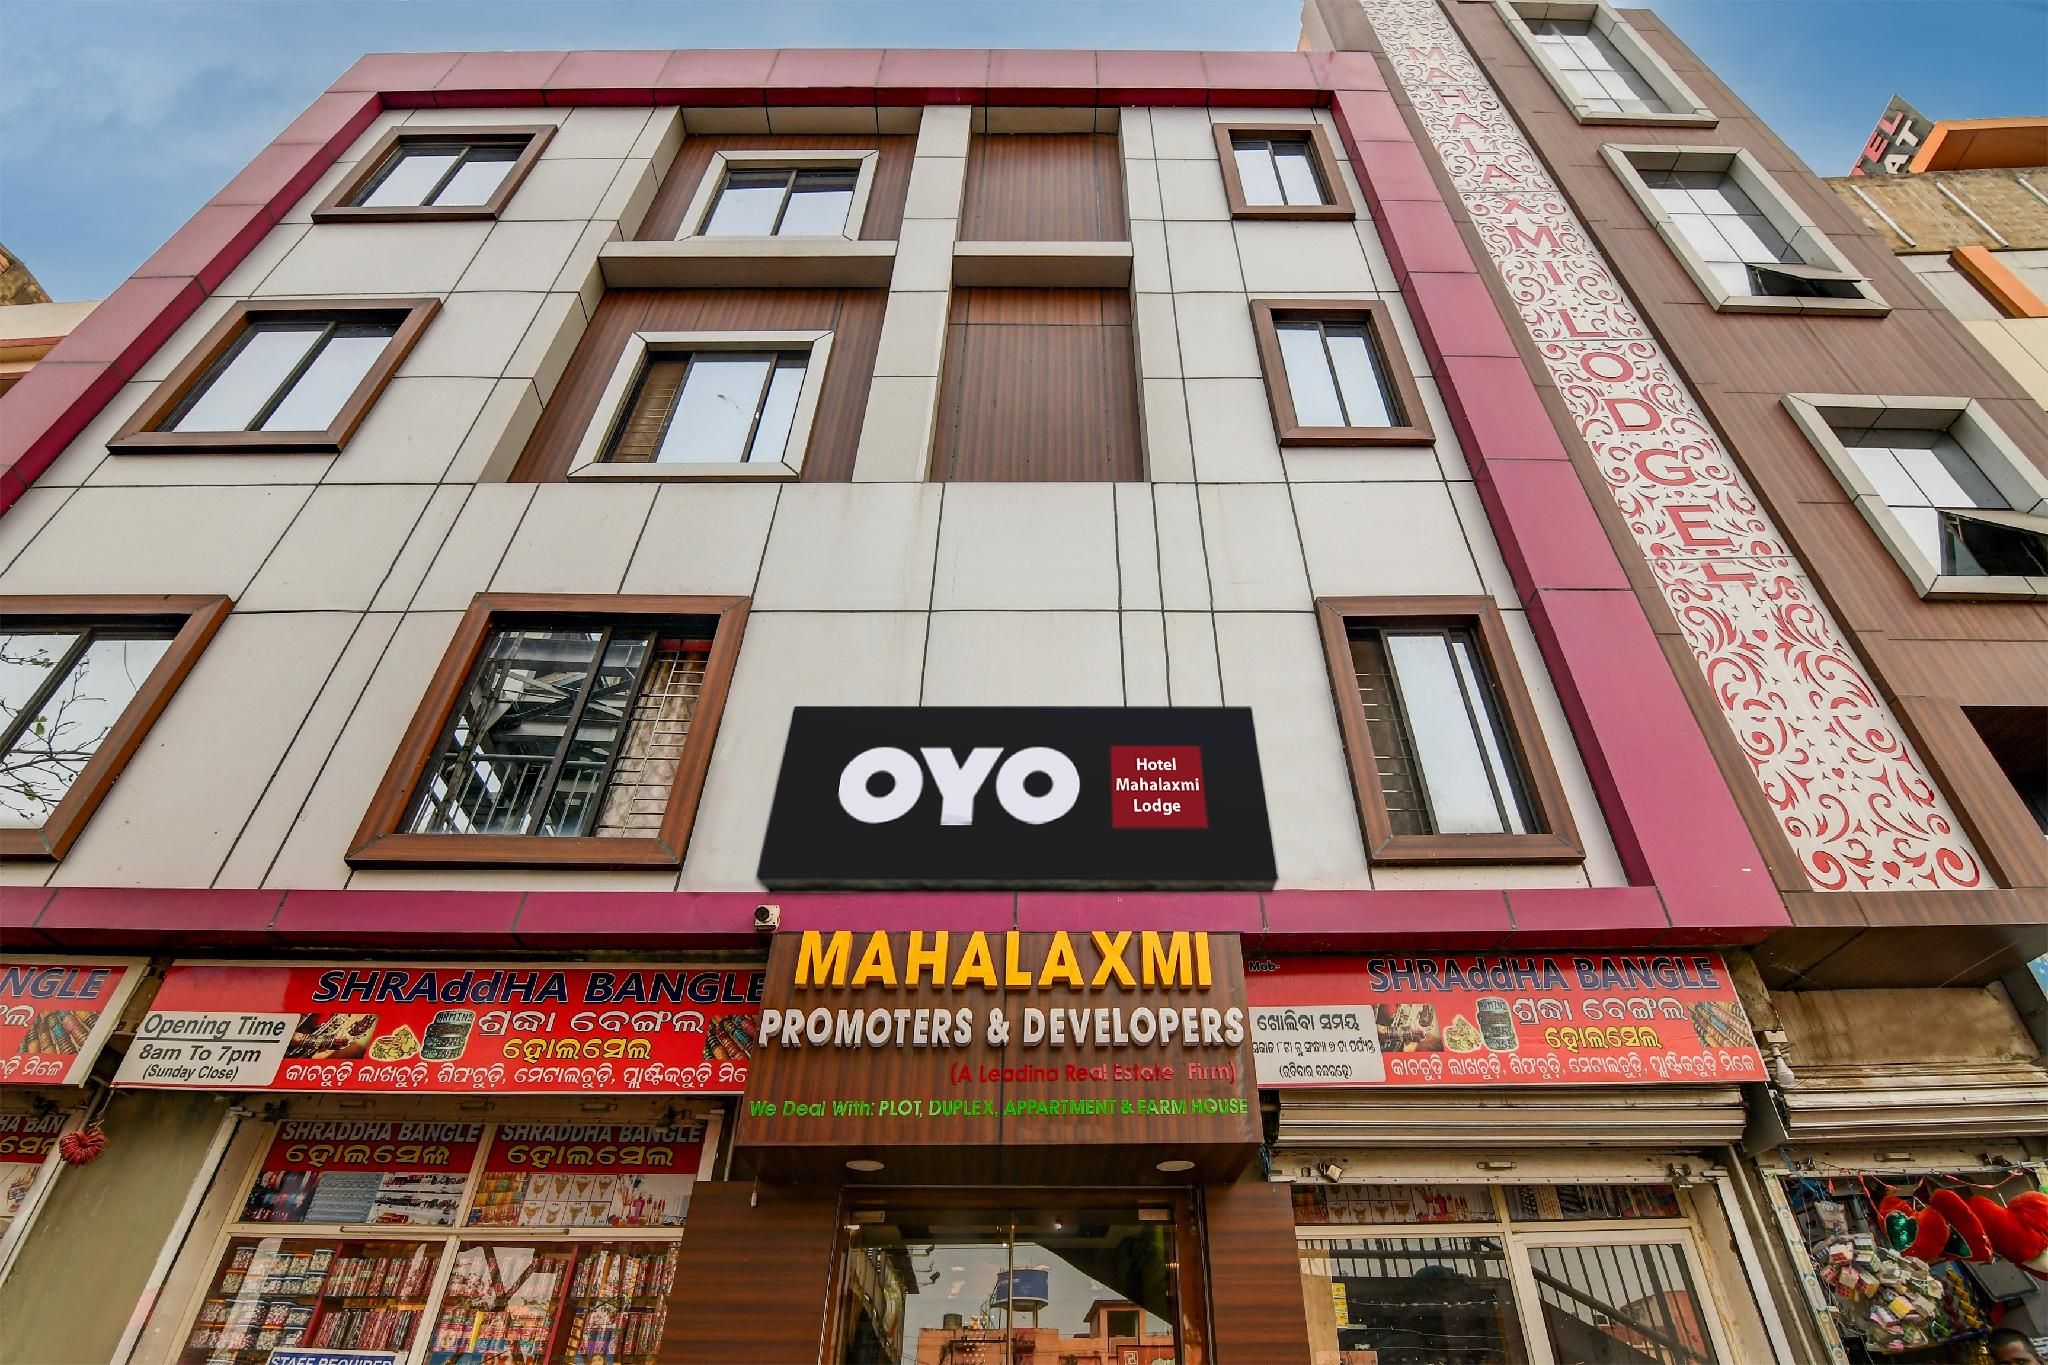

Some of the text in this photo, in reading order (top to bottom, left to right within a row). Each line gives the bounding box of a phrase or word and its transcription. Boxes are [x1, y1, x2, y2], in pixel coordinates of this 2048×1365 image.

[1404, 46, 1565, 286] MAHALAXMI
[1136, 757, 1177, 771] Hotel
[838, 746, 1081, 826] OYO
[1115, 777, 1200, 791] Mahalaxmi
[1133, 798, 1181, 816] Lodge
[794, 929, 1213, 989] MAHALAXMI
[0, 967, 111, 999] NGLE
[1366, 956, 1721, 992] SHRAddHA BANGLE
[311, 969, 767, 1004] SHRAddHA BANGLE
[143, 1013, 286, 1039] Opening Time
[758, 1007, 1245, 1048] PROMOTERS & DEVELOPERS
[139, 1043, 262, 1064] 8am To 7pm
[142, 1064, 239, 1082] (Sunday Close)
[951, 1062, 972, 1085] (A
[1065, 1063, 1108, 1082] Real
[1113, 1063, 1176, 1083] Estate
[1187, 1061, 1237, 1085] Firm)
[750, 1098, 1248, 1118] We Deal With: PLOT, DUPLEX, APPARTMENT & FARM HOUSE
[282, 1121, 481, 1143] SHRADDHA BANGLE
[501, 1124, 702, 1143] SHRADDHA BANGLE
